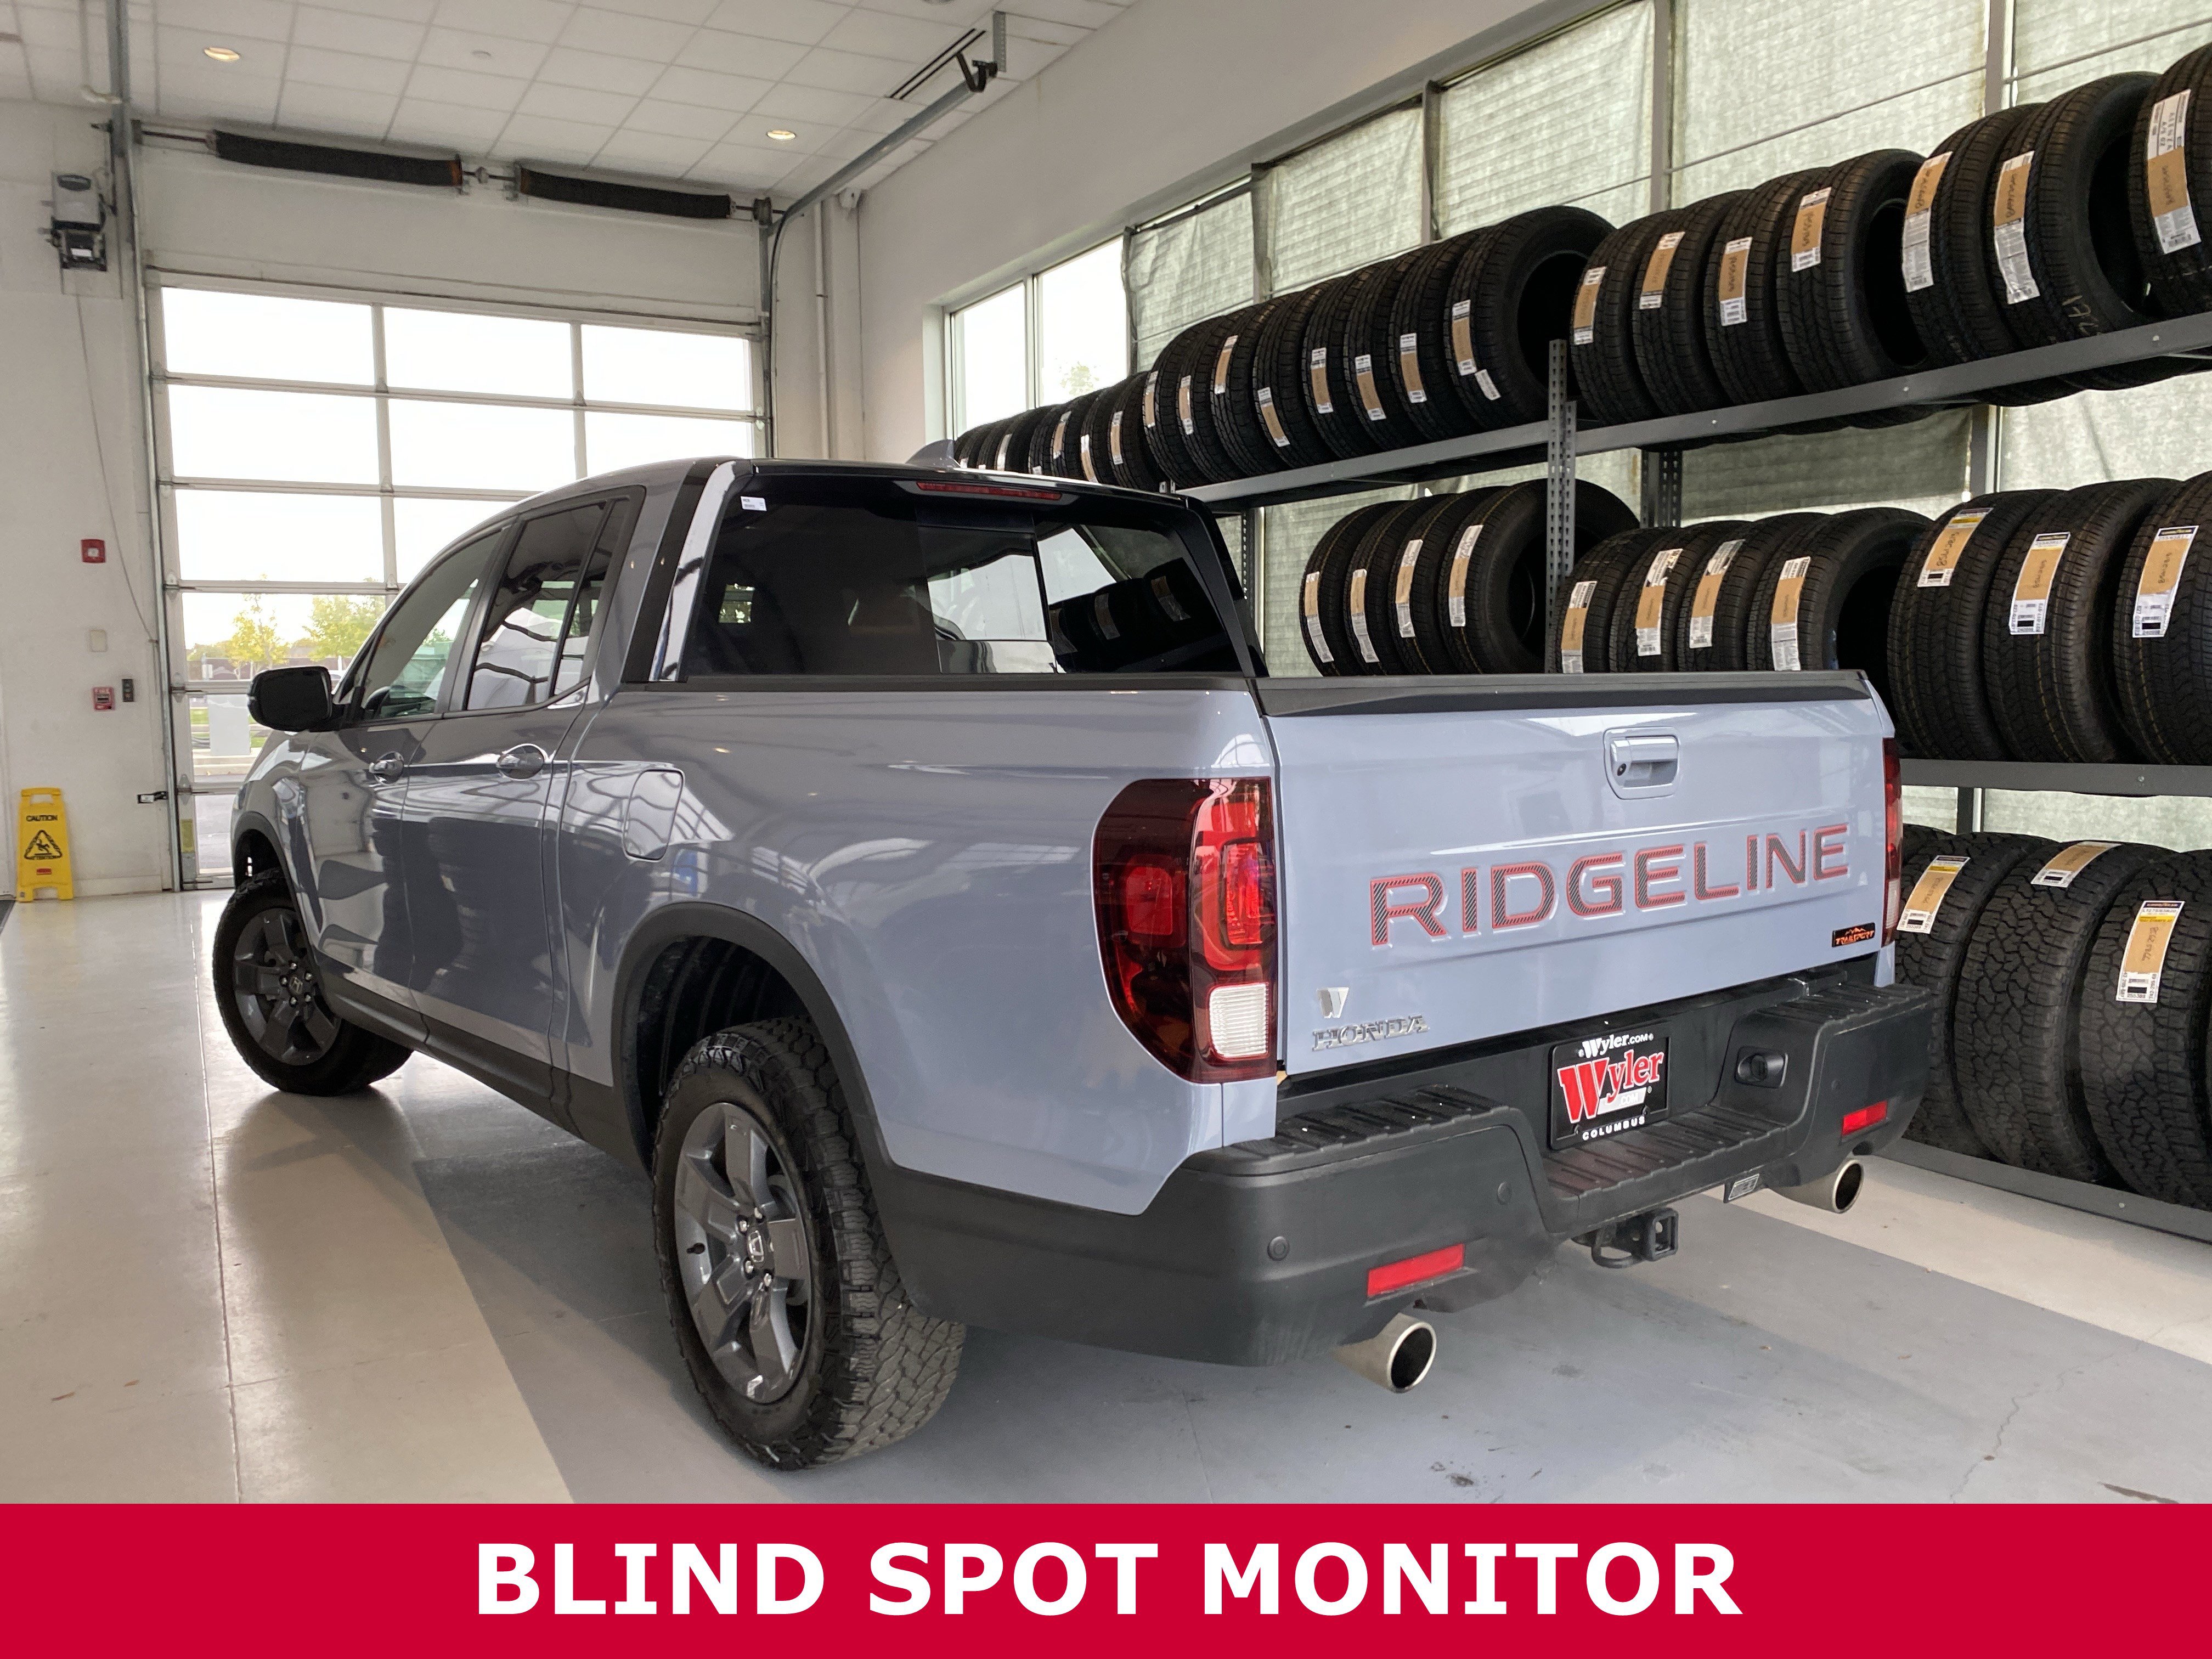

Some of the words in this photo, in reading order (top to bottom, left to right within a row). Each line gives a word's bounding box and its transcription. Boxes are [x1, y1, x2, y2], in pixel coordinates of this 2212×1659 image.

[1370, 824, 1849, 946] RIDGELINE
[1312, 1013, 1430, 1052] HONDA
[1557, 1048, 1665, 1124] Wyler
[1582, 1115, 1645, 1141] COLUMBUS
